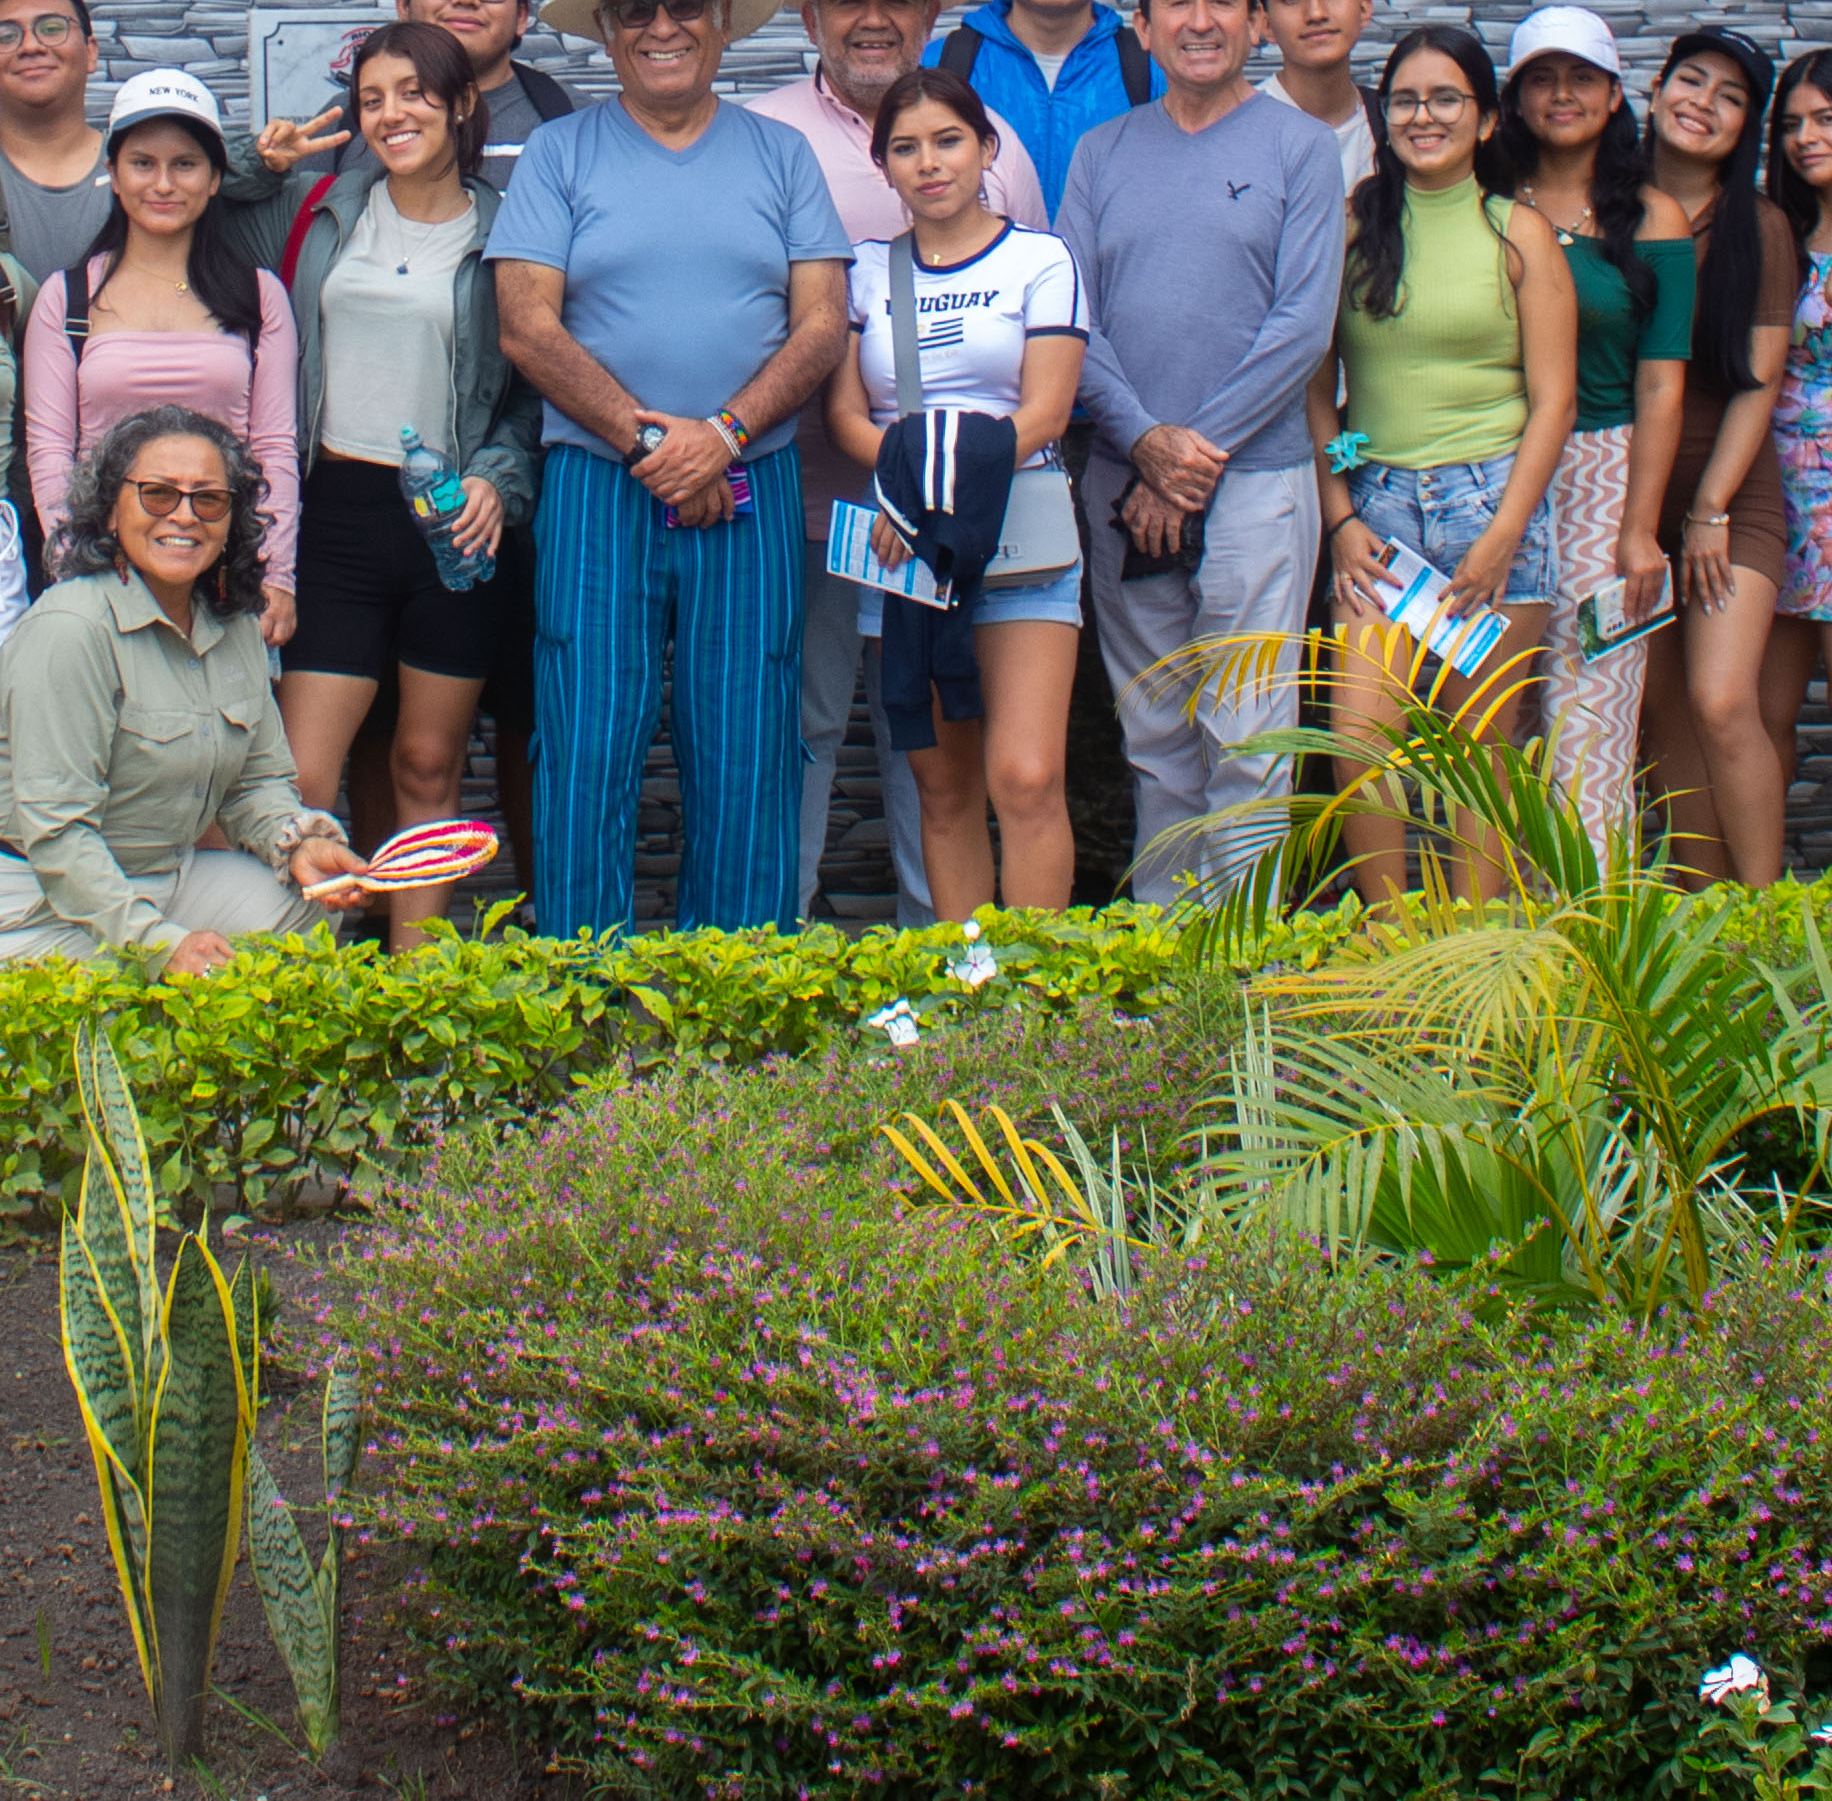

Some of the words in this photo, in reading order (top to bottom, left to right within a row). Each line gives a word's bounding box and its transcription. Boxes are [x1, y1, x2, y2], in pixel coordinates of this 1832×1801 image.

[149, 87, 171, 95] NEW
[175, 87, 199, 102] YORK
[885, 289, 1000, 316] UGUAY
